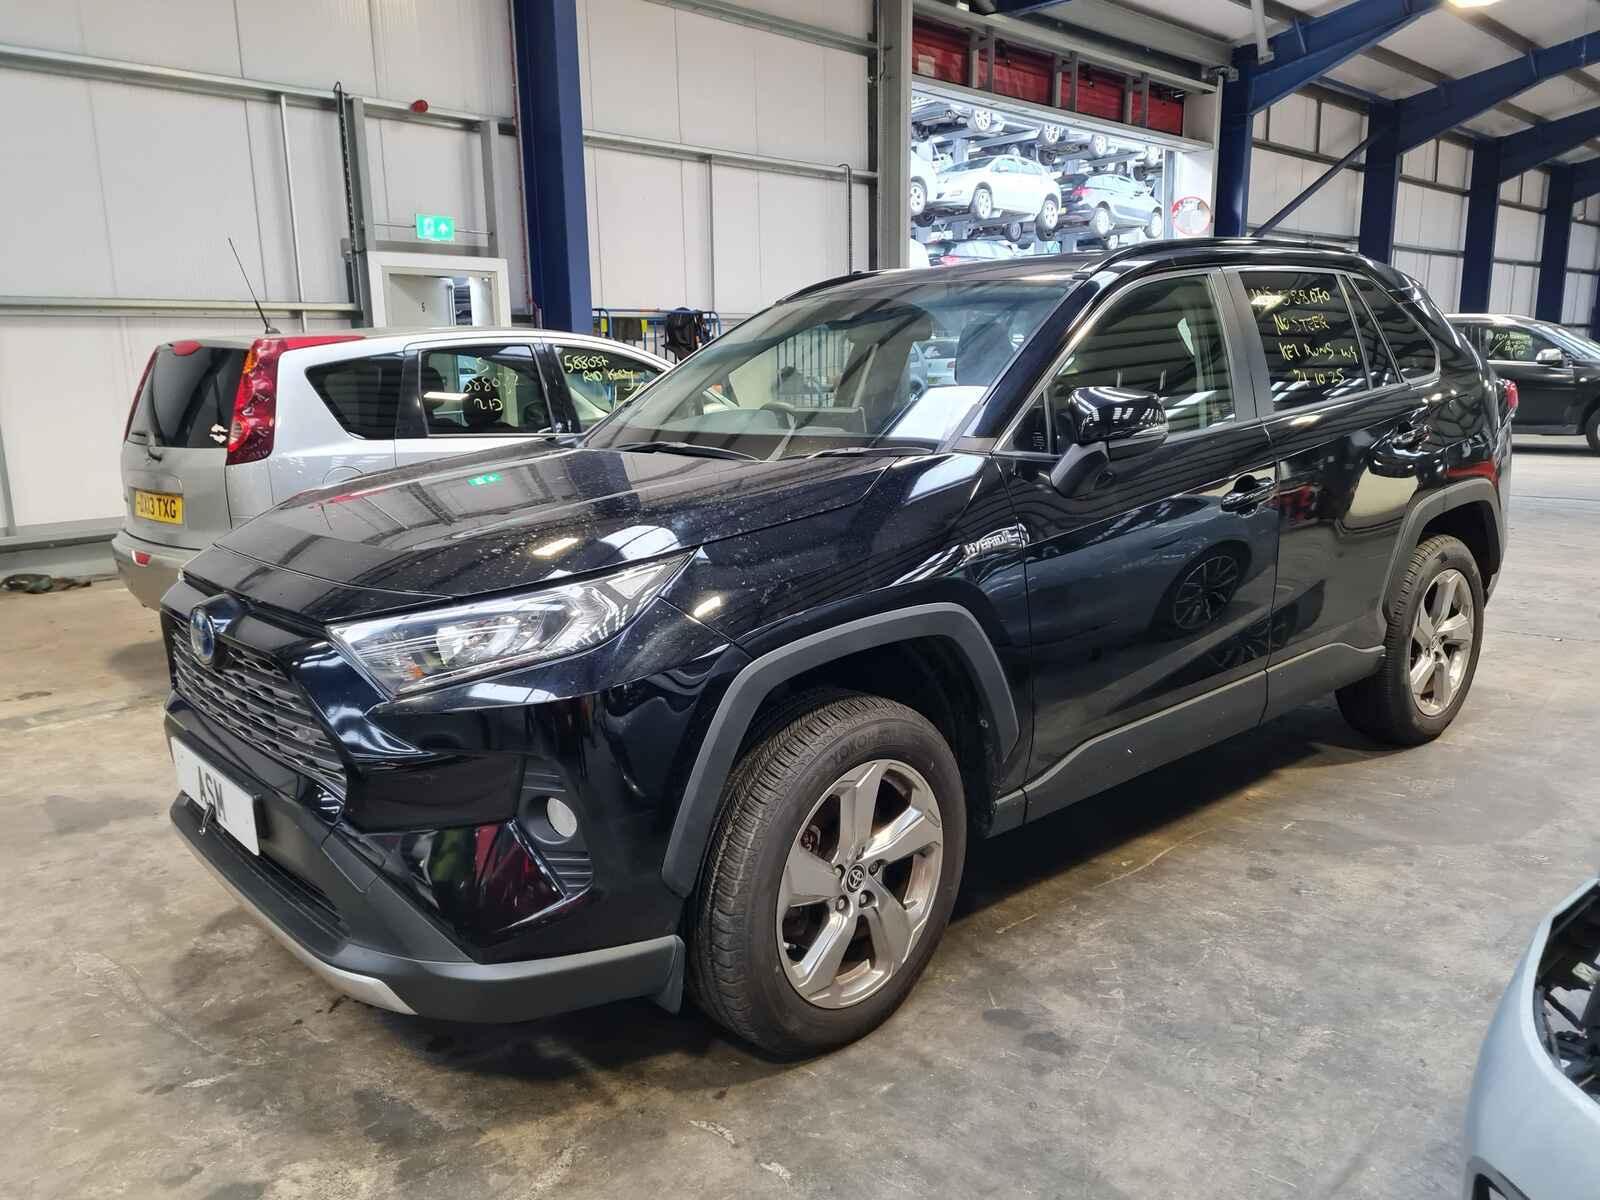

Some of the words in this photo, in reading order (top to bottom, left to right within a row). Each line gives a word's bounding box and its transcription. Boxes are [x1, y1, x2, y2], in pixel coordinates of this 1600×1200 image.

[156, 498, 177, 518] TXG
[964, 534, 1006, 555] HYBRID
[198, 766, 229, 822] ASM
